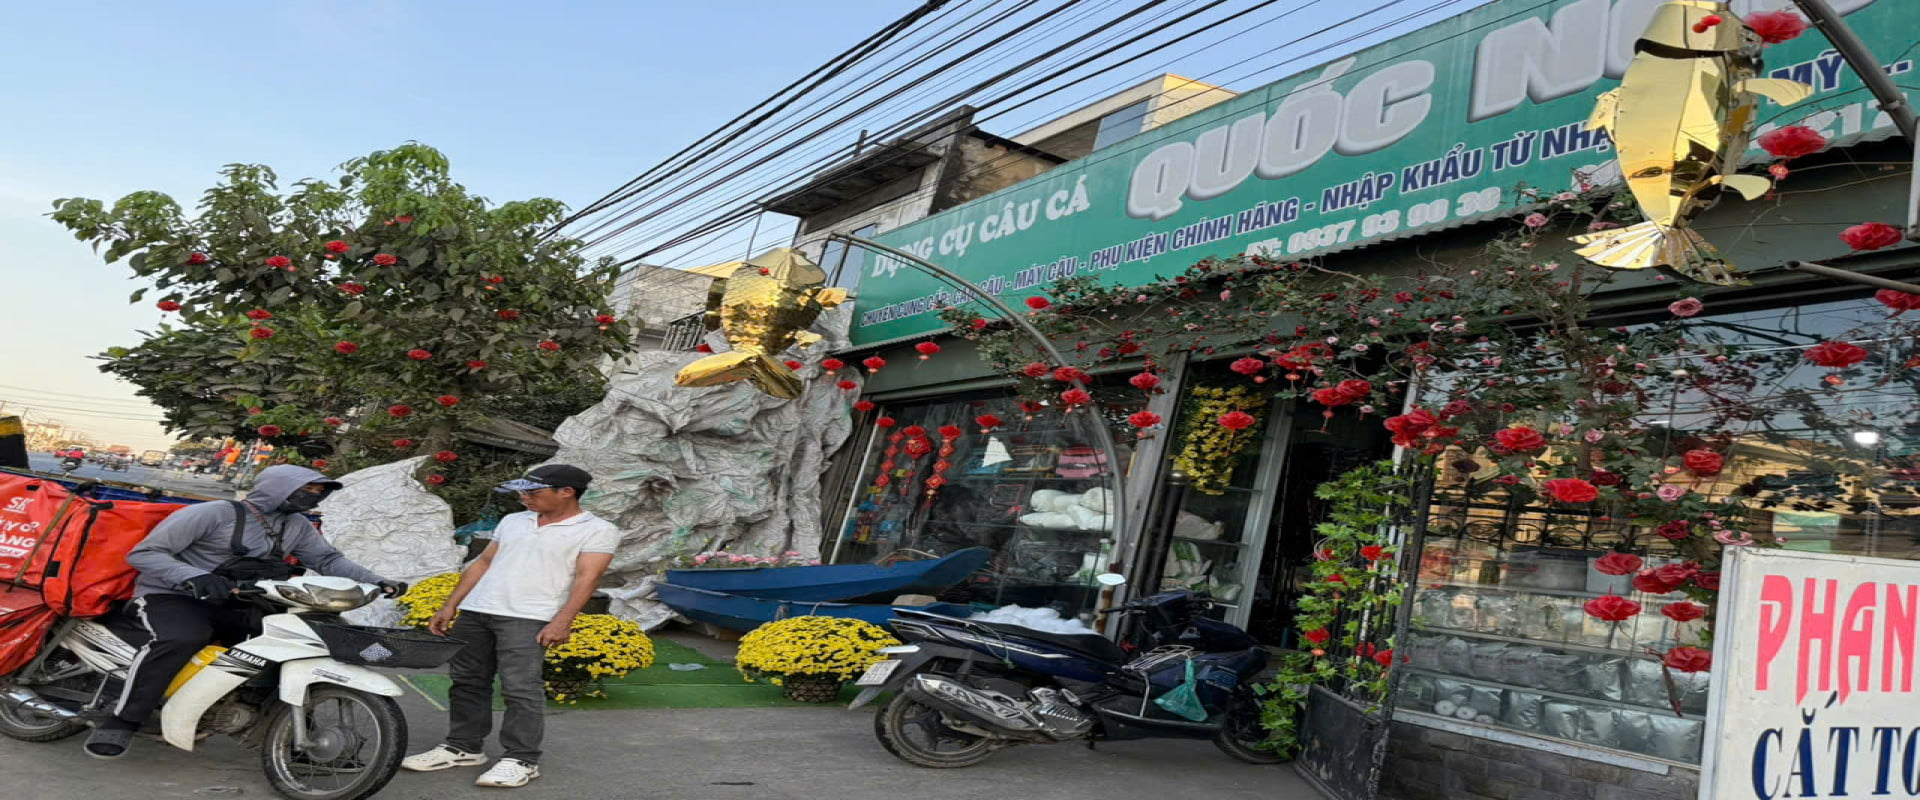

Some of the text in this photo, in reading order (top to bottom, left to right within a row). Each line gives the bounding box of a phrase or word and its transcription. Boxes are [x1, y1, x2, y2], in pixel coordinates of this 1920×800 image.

[1126, 57, 1436, 221] QUỐC
[938, 221, 975, 258] CỤ
[979, 201, 1041, 243] CÂU
[1045, 174, 1091, 221] CÁ
[1013, 264, 1047, 291] MÁY
[1046, 255, 1078, 282] CÂU
[1089, 241, 1124, 271] PHỤ
[1125, 233, 1168, 263] KIỆN
[1171, 216, 1232, 250] CHÍNH
[1236, 196, 1300, 235] HÃNG
[1320, 171, 1395, 211] NHẬP
[1400, 142, 1485, 195] KHẨU
[1491, 130, 1539, 172] TỪ
[229, 648, 267, 668] YAMAHA
[1755, 574, 1920, 706] PHAN
[1752, 690, 1860, 800] CẮT
